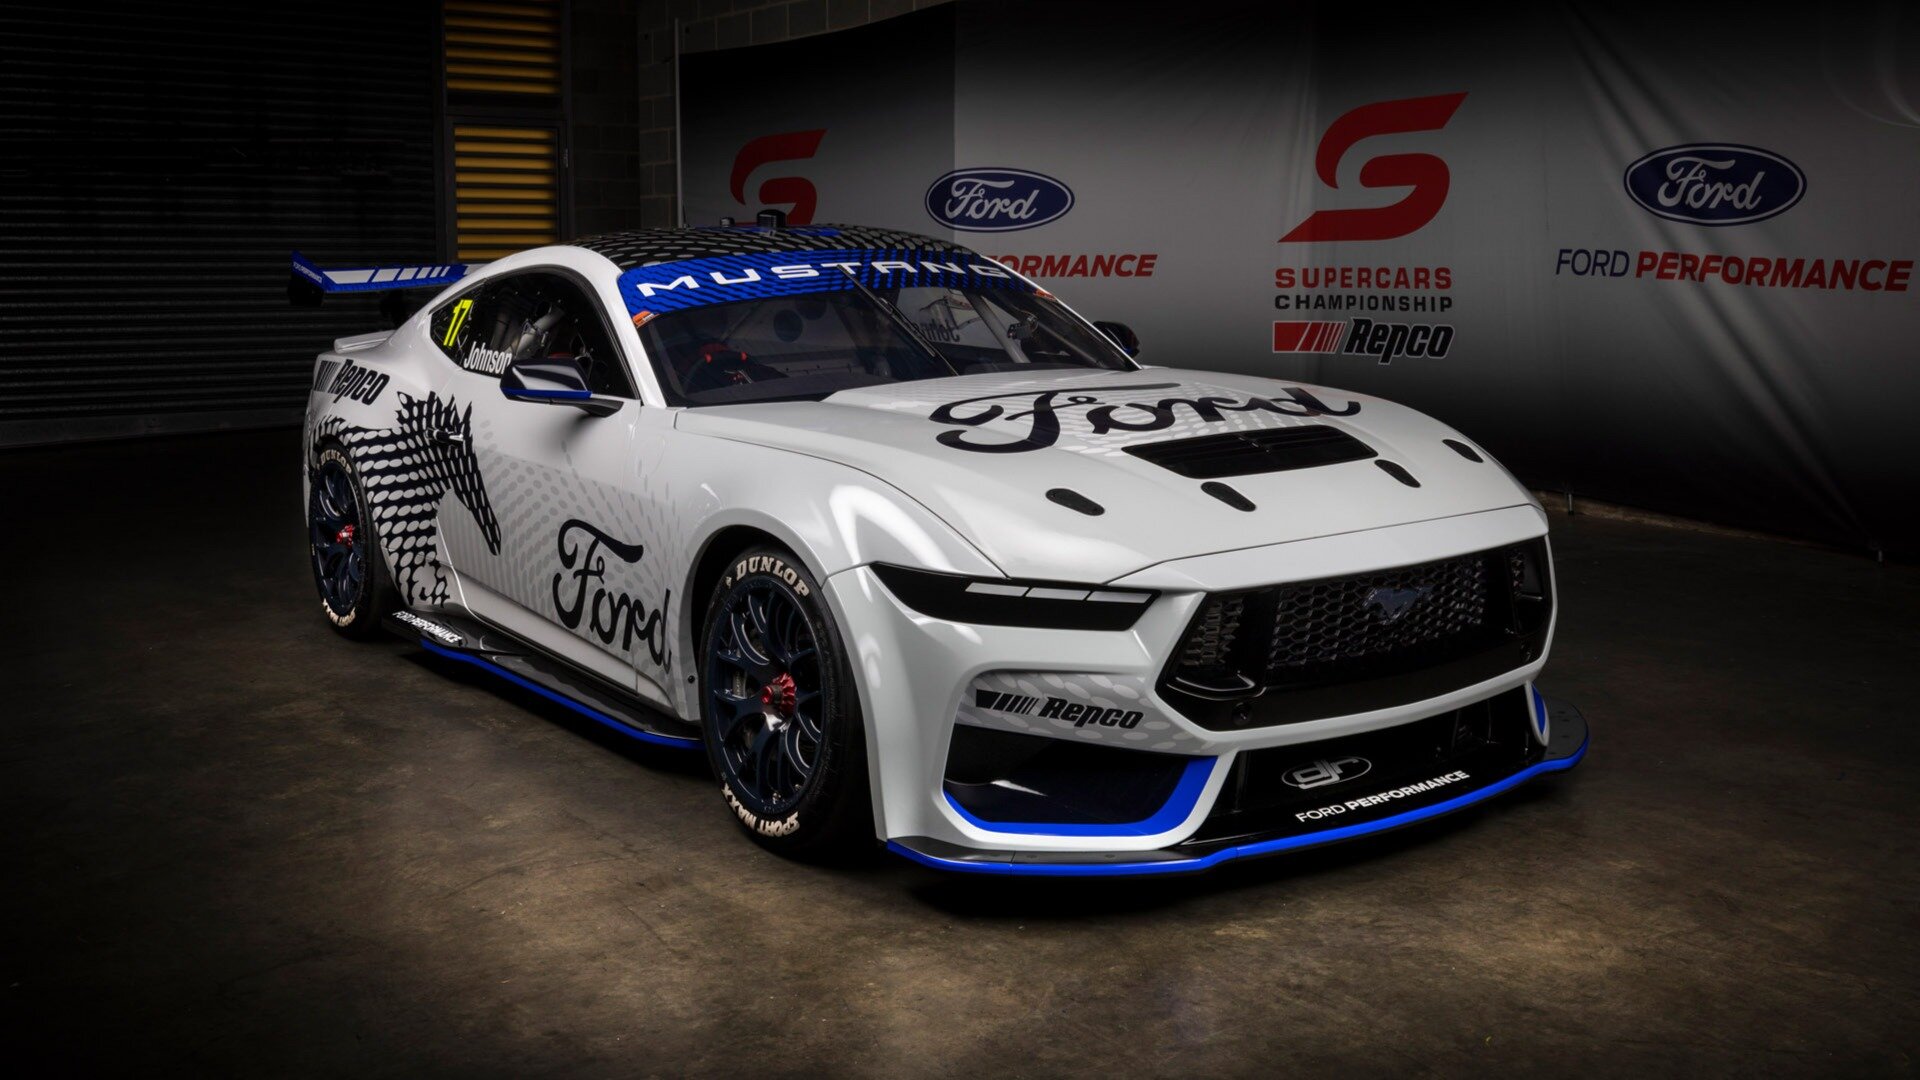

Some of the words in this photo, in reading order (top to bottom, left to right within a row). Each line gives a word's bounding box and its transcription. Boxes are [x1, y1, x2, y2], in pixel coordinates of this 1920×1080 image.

[944, 178, 1040, 220] Ford
[1657, 156, 1766, 210] Ford
[636, 258, 1011, 298] MUSTANG
[985, 254, 1158, 278] ORMANCE
[1275, 267, 1452, 290] SUPERCARS
[1555, 249, 1630, 278] FORD
[1635, 251, 1914, 292] PERFORMANCE
[443, 299, 474, 347] 17
[1275, 294, 1453, 313] CHAMPIONSHIP
[463, 340, 513, 375] Johnson
[1343, 317, 1455, 364] Repco
[327, 359, 390, 405] Repco
[929, 384, 1361, 454] Ford
[319, 449, 353, 475] DUNLOP
[552, 519, 672, 674] Ford
[735, 555, 811, 598] DUNLOP
[1038, 697, 1144, 729] Repco
[1294, 804, 1347, 823] FORD
[1344, 769, 1471, 811] PERFORMANCE
[757, 811, 801, 838] SPORT
